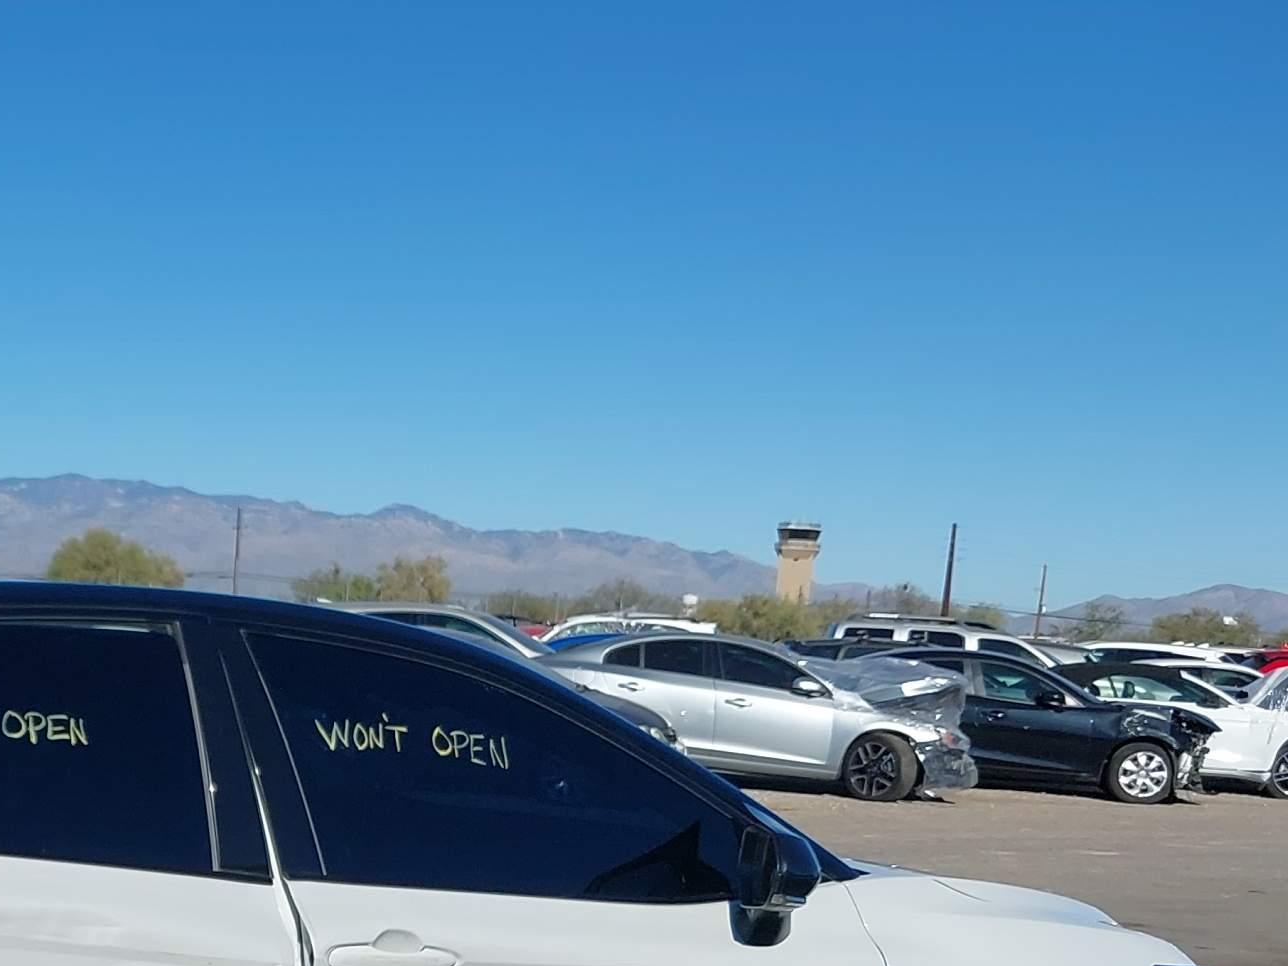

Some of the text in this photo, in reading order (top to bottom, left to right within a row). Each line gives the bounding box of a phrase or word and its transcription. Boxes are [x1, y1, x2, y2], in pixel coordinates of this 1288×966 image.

[1, 710, 89, 747] OPEN
[314, 712, 509, 770] WON'T OPEN
